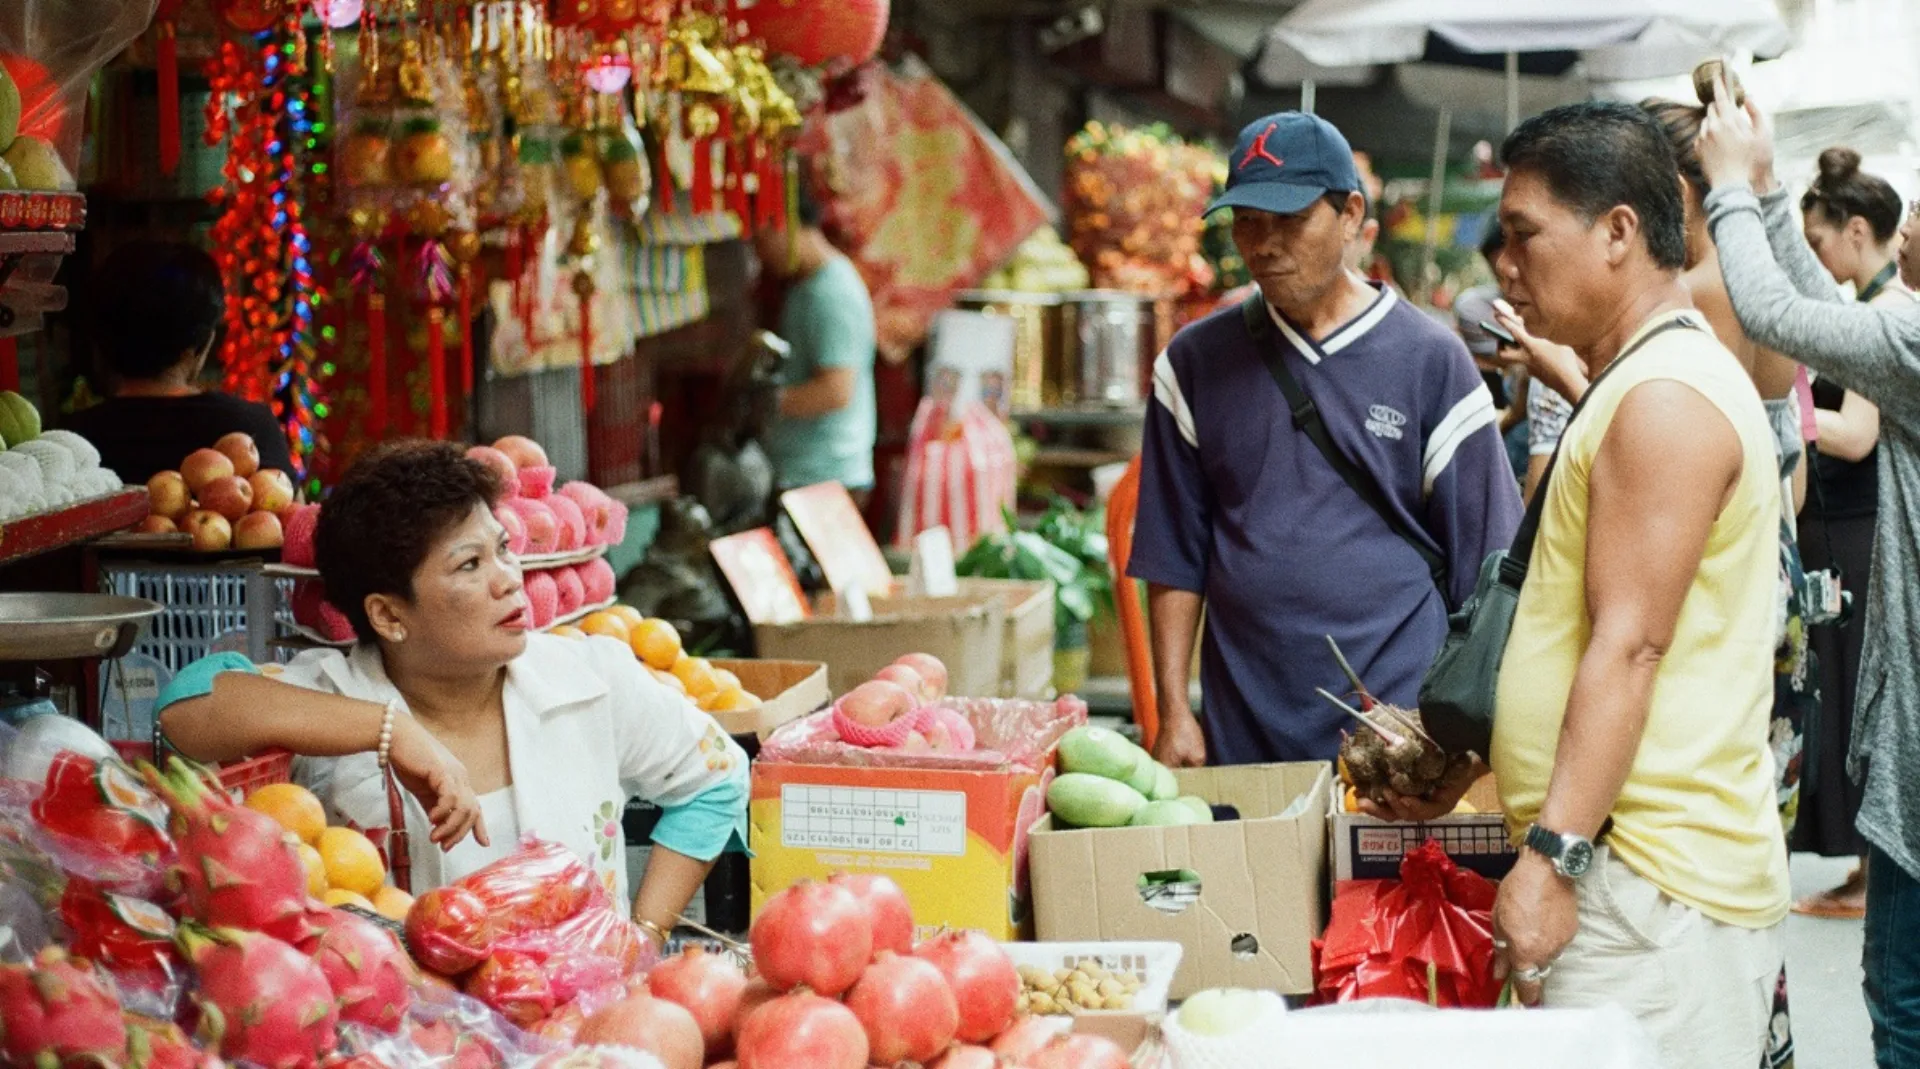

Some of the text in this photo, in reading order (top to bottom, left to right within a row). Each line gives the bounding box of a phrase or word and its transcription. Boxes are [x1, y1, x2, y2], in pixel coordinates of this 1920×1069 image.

[832, 806, 851, 815] 175
[853, 807, 872, 816] 163
[786, 833, 805, 841] 125
[810, 834, 828, 843] 113
[857, 837, 870, 845] 88
[879, 838, 892, 847] 80
[901, 839, 914, 848] 72
